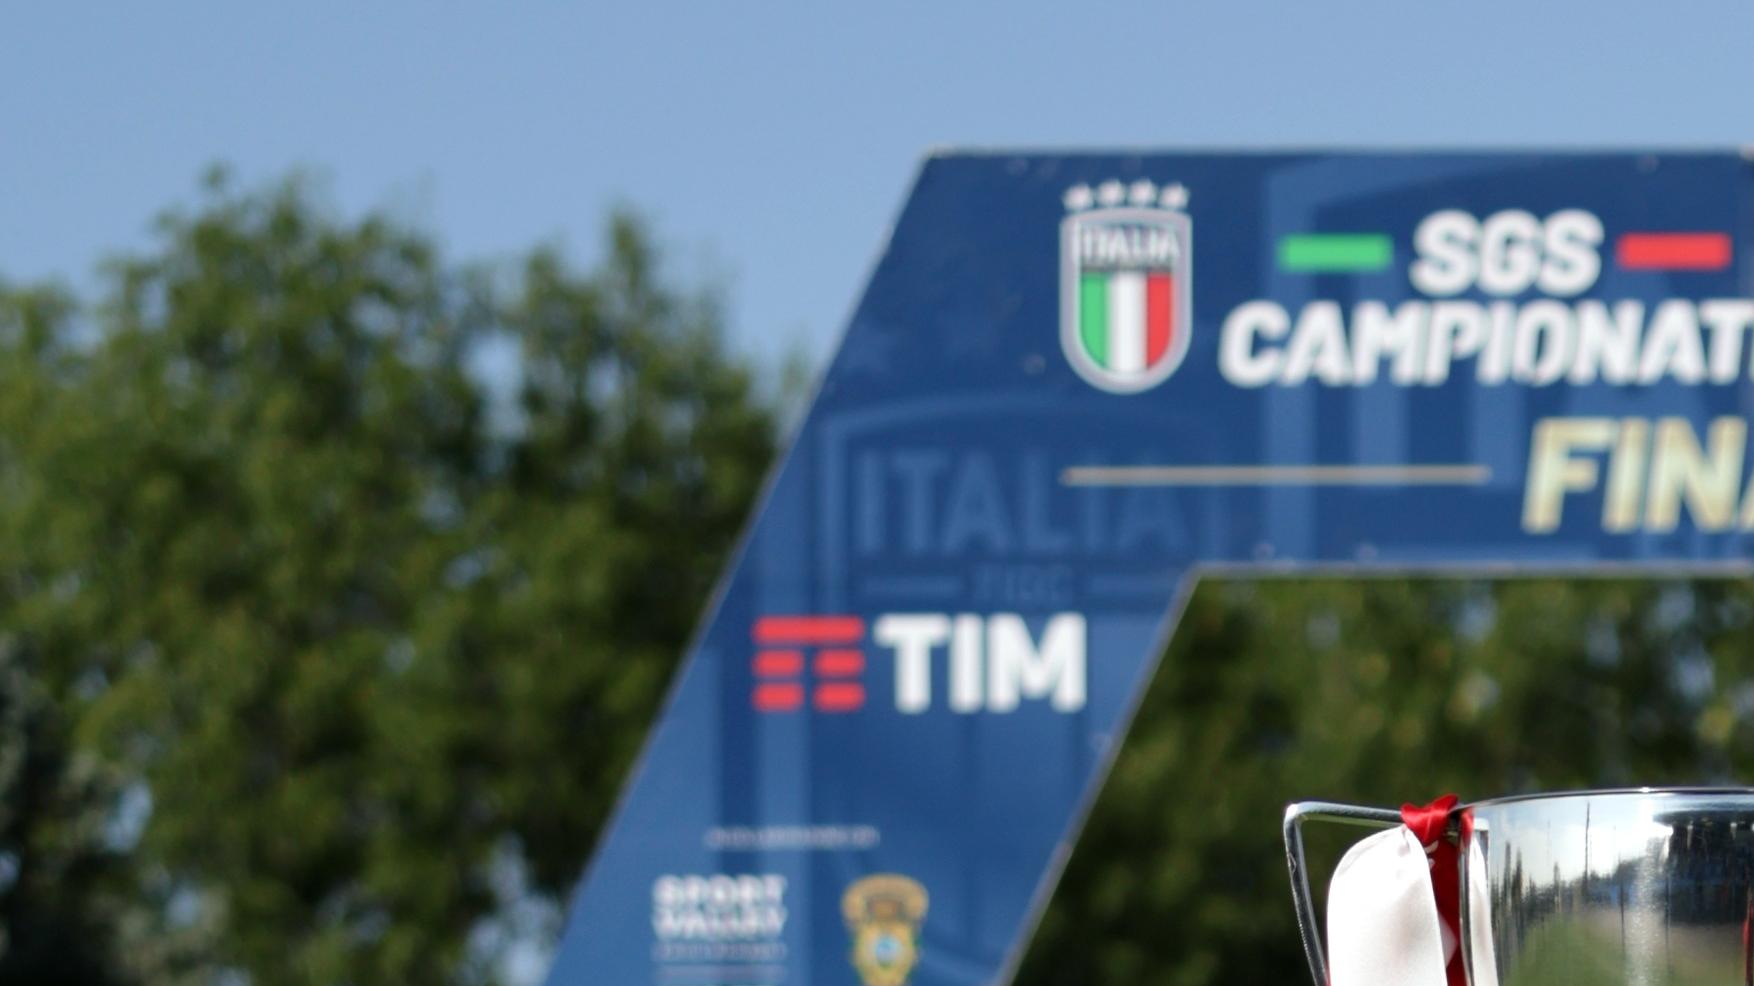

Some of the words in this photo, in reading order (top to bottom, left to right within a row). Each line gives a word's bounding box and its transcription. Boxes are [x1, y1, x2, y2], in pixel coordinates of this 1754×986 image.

[1080, 226, 1181, 260] ITALIA
[1408, 209, 1604, 297] SGS
[857, 451, 1194, 552] ITALIA
[873, 612, 1088, 714] TIM
